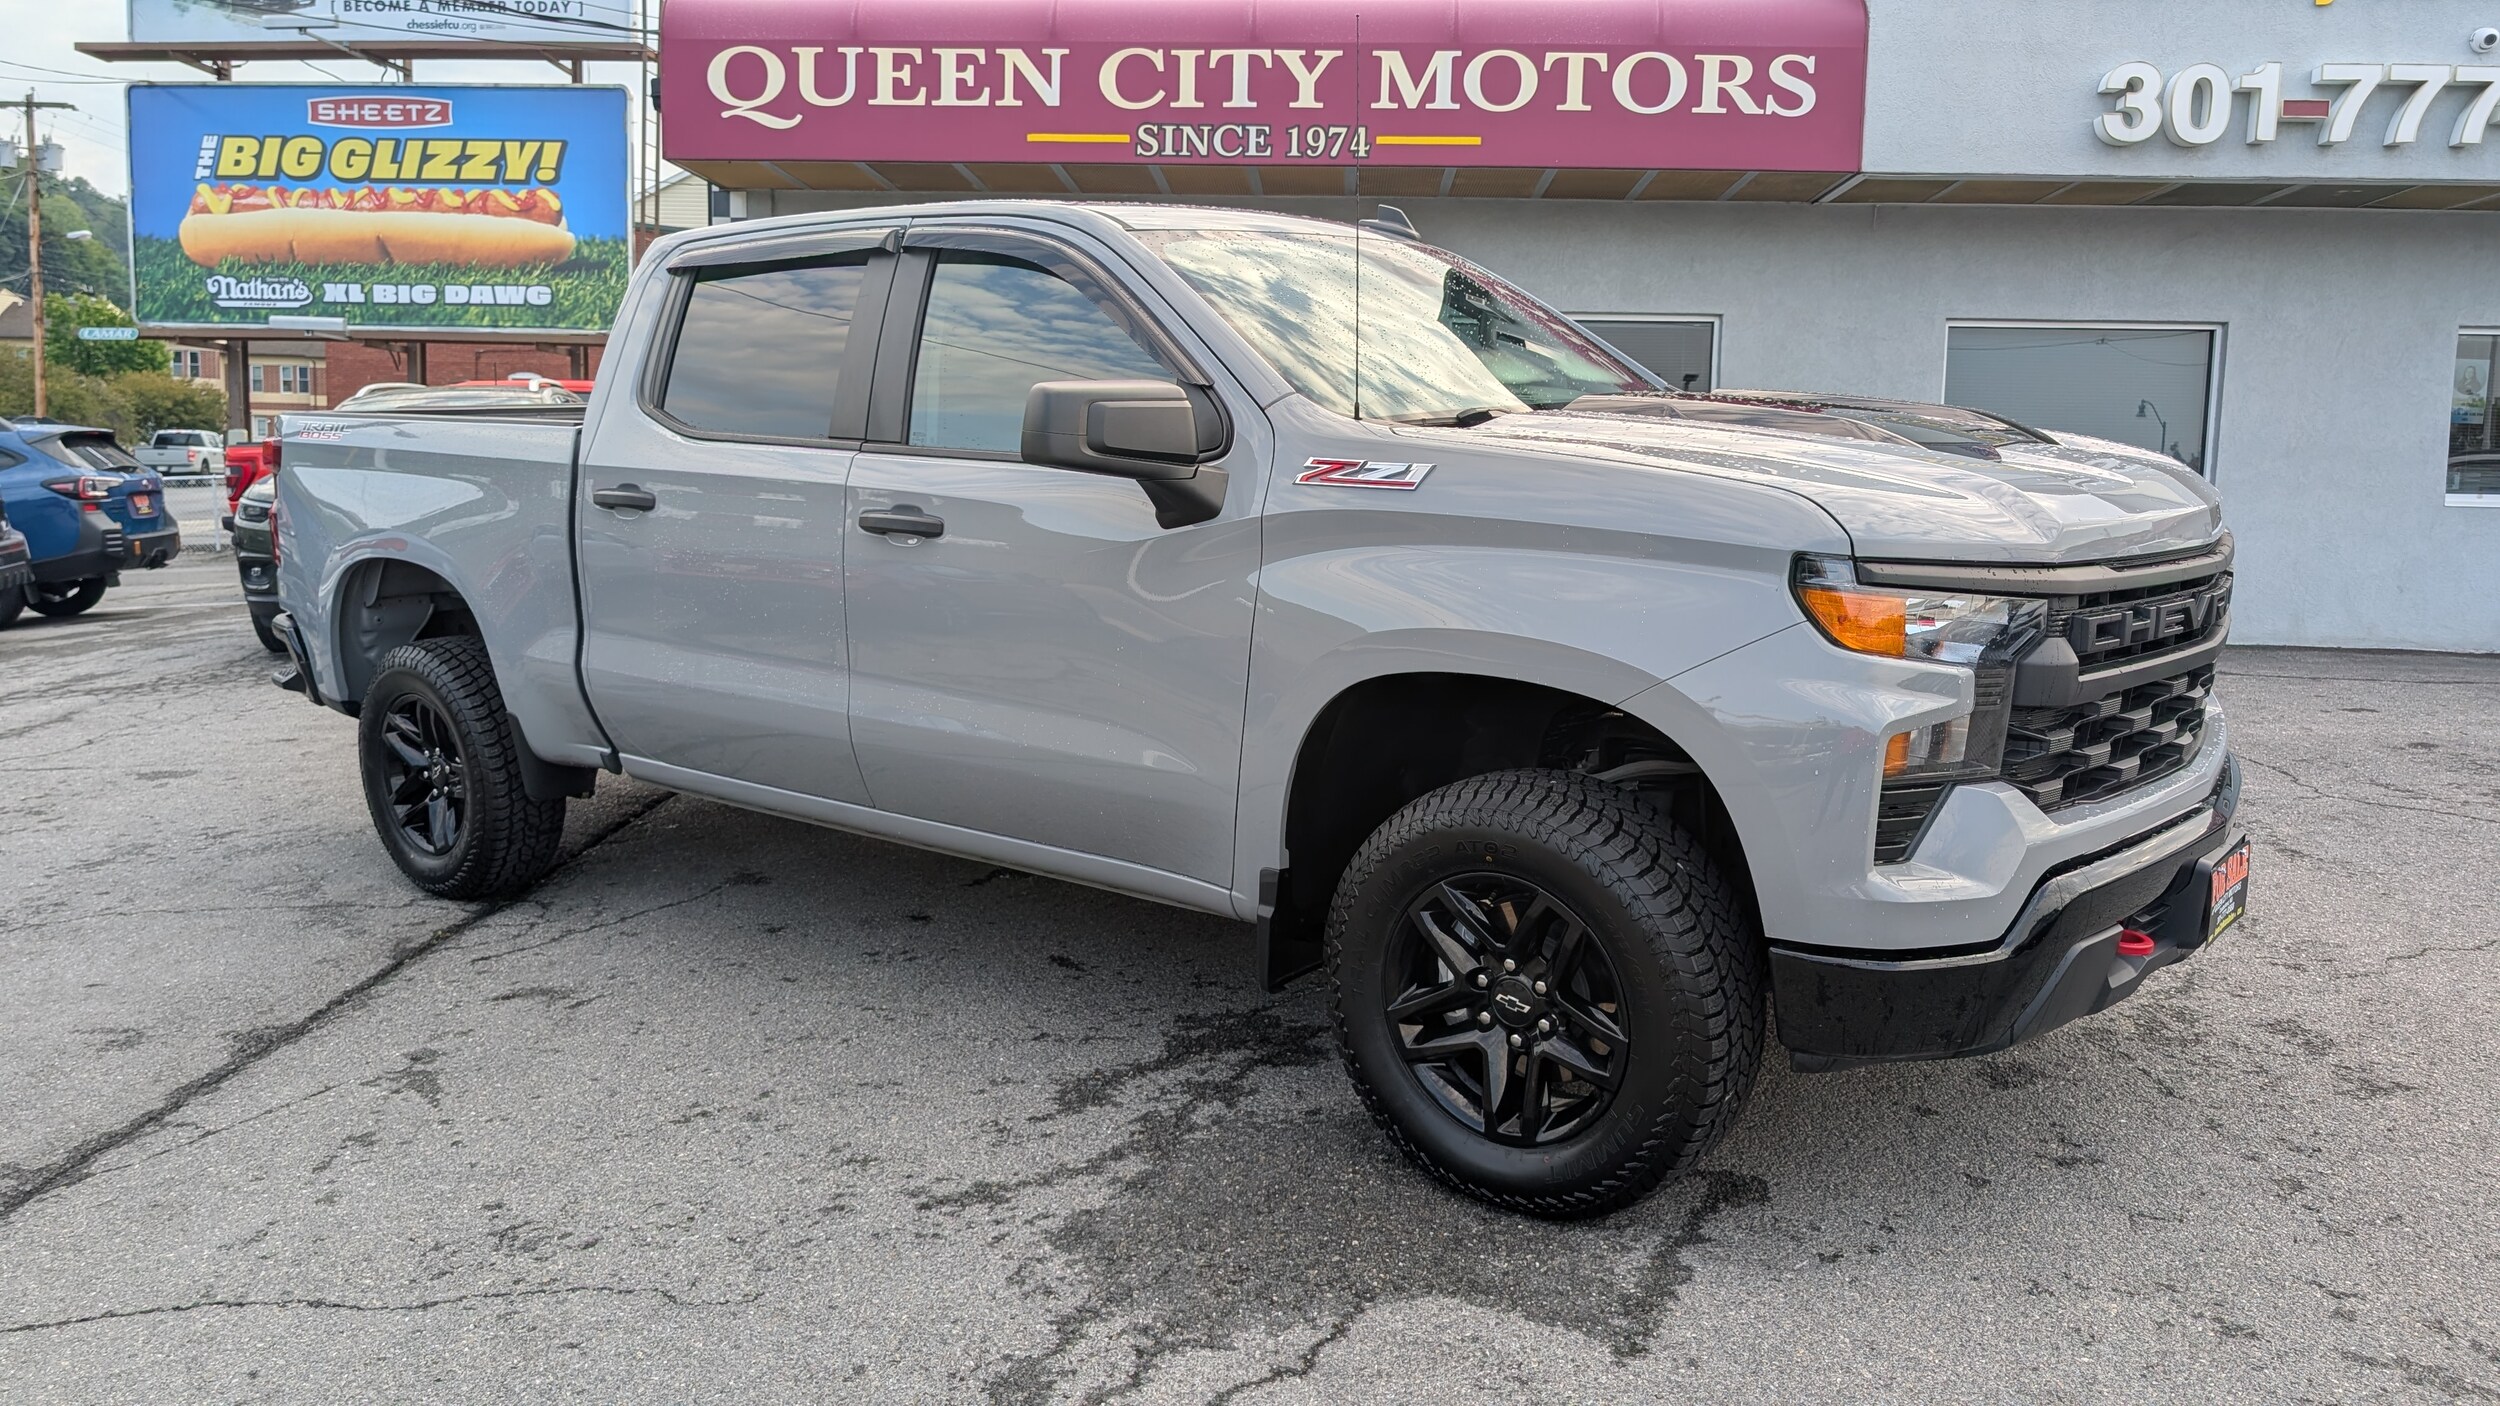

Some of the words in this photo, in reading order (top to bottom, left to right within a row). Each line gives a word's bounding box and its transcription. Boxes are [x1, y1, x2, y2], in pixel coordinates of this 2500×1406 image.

[343, 0, 412, 13] BECOME
[419, 1, 431, 13] A
[437, 0, 507, 13] MEMBER
[514, 0, 571, 14] TODAY
[406, 18, 478, 33] chessiefcu.org
[706, 45, 1071, 130] QUEEN
[1098, 47, 1344, 110] CITY
[1370, 49, 1819, 118] MOTORS
[317, 103, 443, 123] SHEETZ
[1135, 123, 1272, 158] SINCE
[1284, 124, 1370, 159] 1974
[194, 134, 219, 180] THE
[214, 135, 325, 180] BIG
[328, 137, 565, 183] GLIZZY!
[206, 275, 314, 304] Nathan's
[322, 283, 366, 303] XL
[372, 284, 438, 304] BIG
[444, 285, 553, 305] DAWG
[298, 421, 352, 434] TRAIL
[299, 431, 343, 441] BOSS
[1292, 457, 1437, 491] Z71
